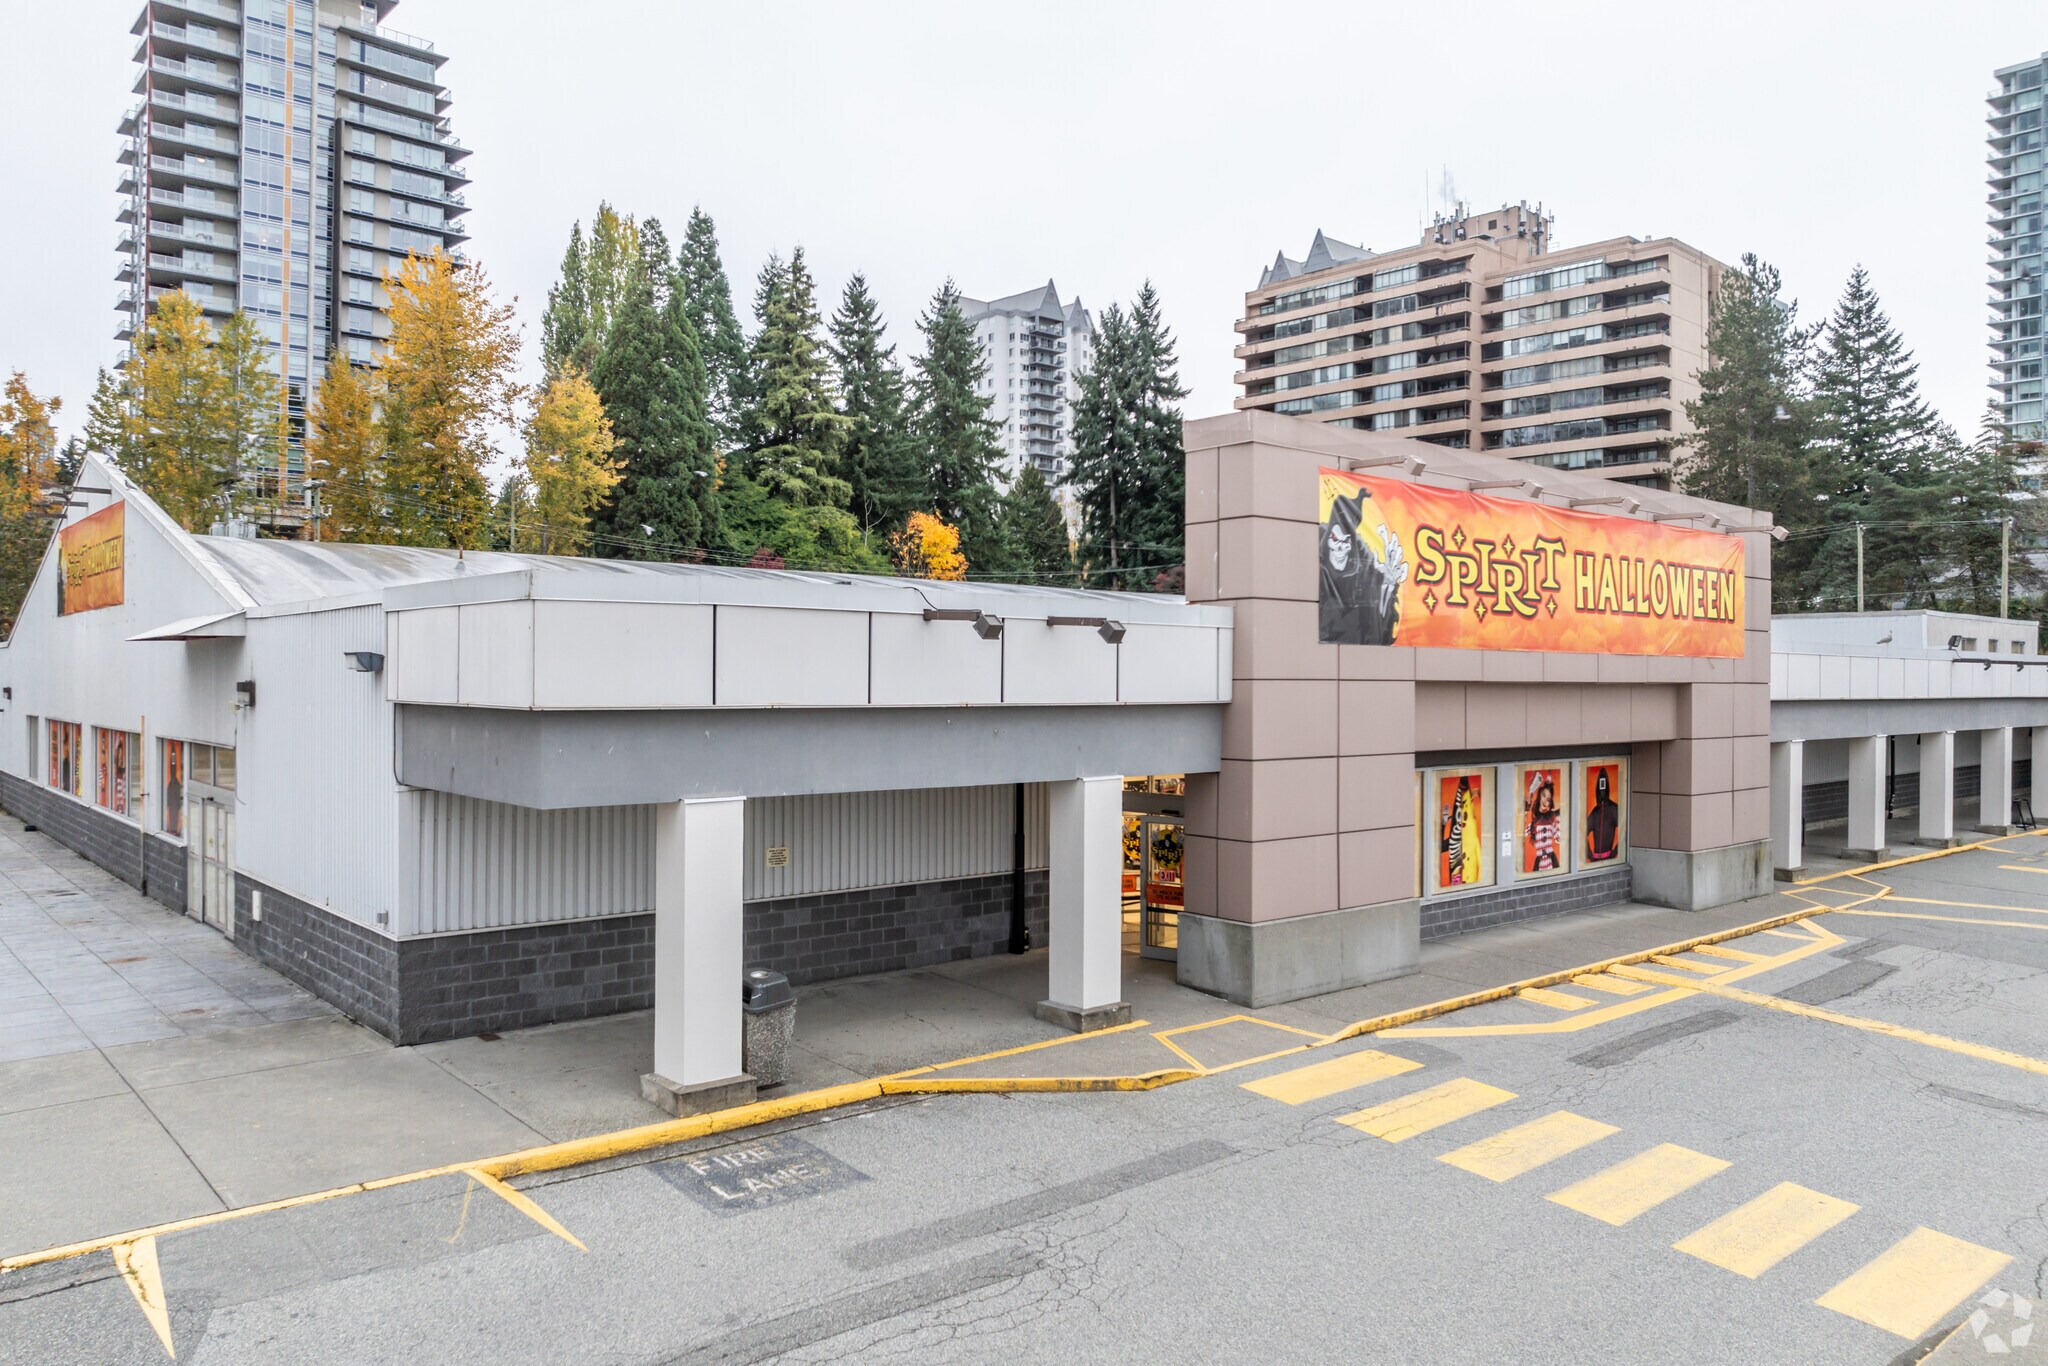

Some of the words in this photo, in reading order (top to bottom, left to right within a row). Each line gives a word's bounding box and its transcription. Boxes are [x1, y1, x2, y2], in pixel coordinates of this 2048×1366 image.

[1416, 523, 1565, 618] SPIRIT
[1573, 550, 1735, 622] HALLOWEEN
[1123, 838, 1140, 848] SPI
[1152, 846, 1183, 861] SPIRIT
[1160, 870, 1175, 882] EXIT
